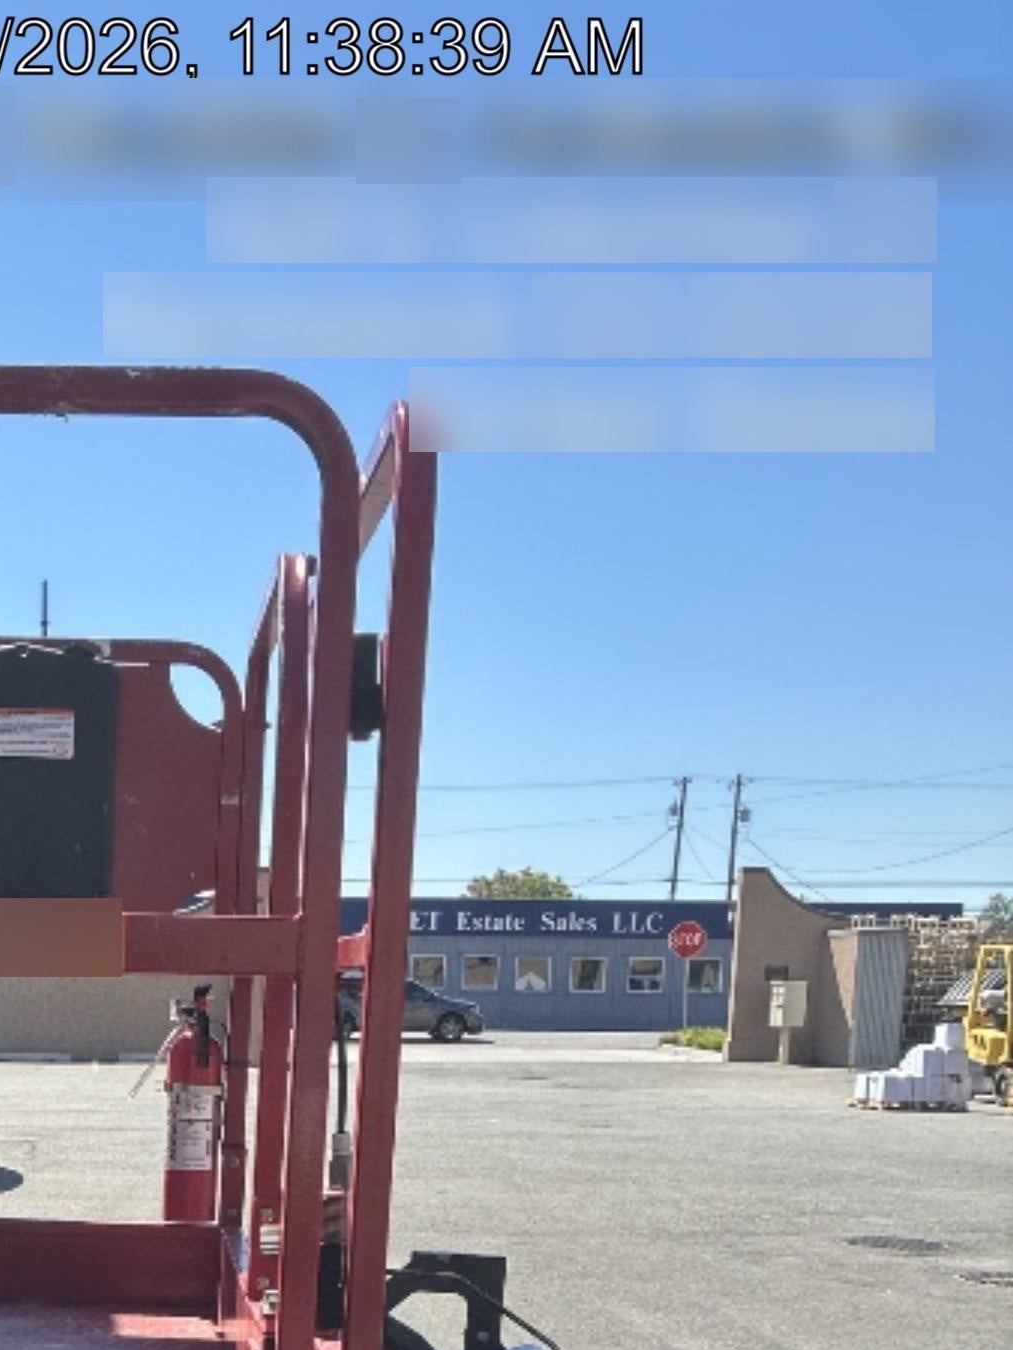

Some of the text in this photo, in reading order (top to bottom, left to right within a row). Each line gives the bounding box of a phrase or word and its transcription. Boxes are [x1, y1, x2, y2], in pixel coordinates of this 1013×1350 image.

[457, 911, 526, 931] Estate
[540, 911, 597, 931] Sales
[612, 911, 664, 934] LLC
